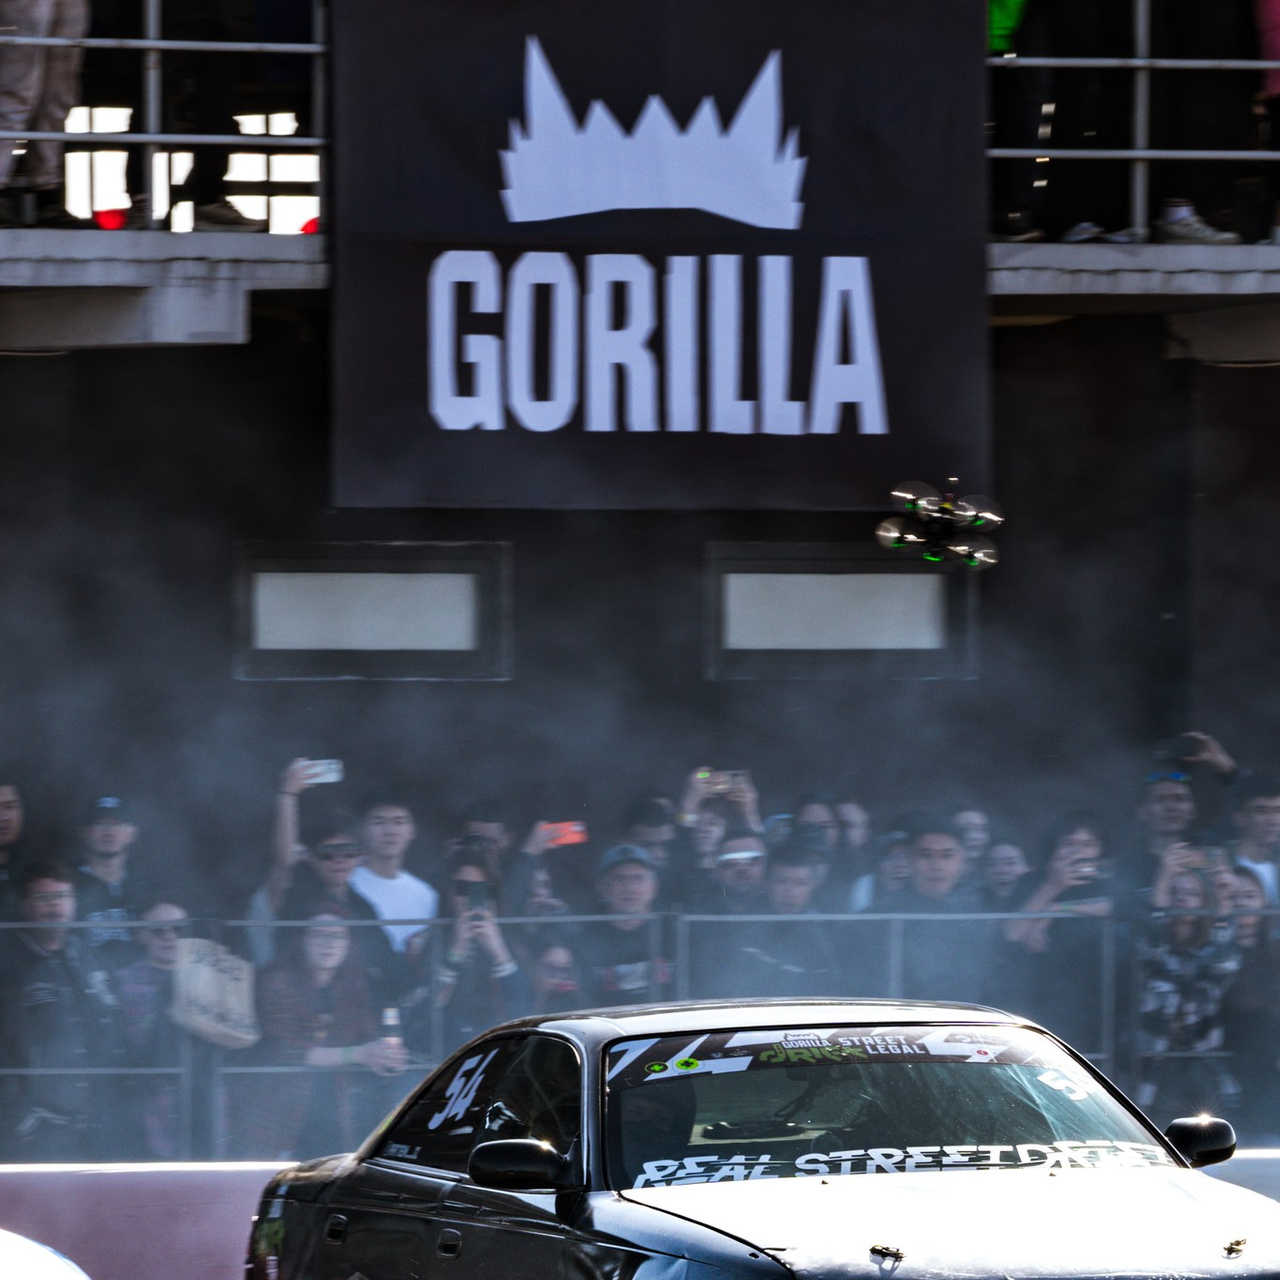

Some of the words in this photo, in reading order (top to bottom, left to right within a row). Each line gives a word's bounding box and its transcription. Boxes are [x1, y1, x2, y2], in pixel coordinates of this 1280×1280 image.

[427, 250, 890, 435] GORILLA
[781, 1038, 832, 1049] GORILLA
[838, 1035, 906, 1046] STREET
[865, 1044, 926, 1055] LEGAL
[427, 1048, 500, 1130] 54
[632, 1154, 780, 1190] REAL
